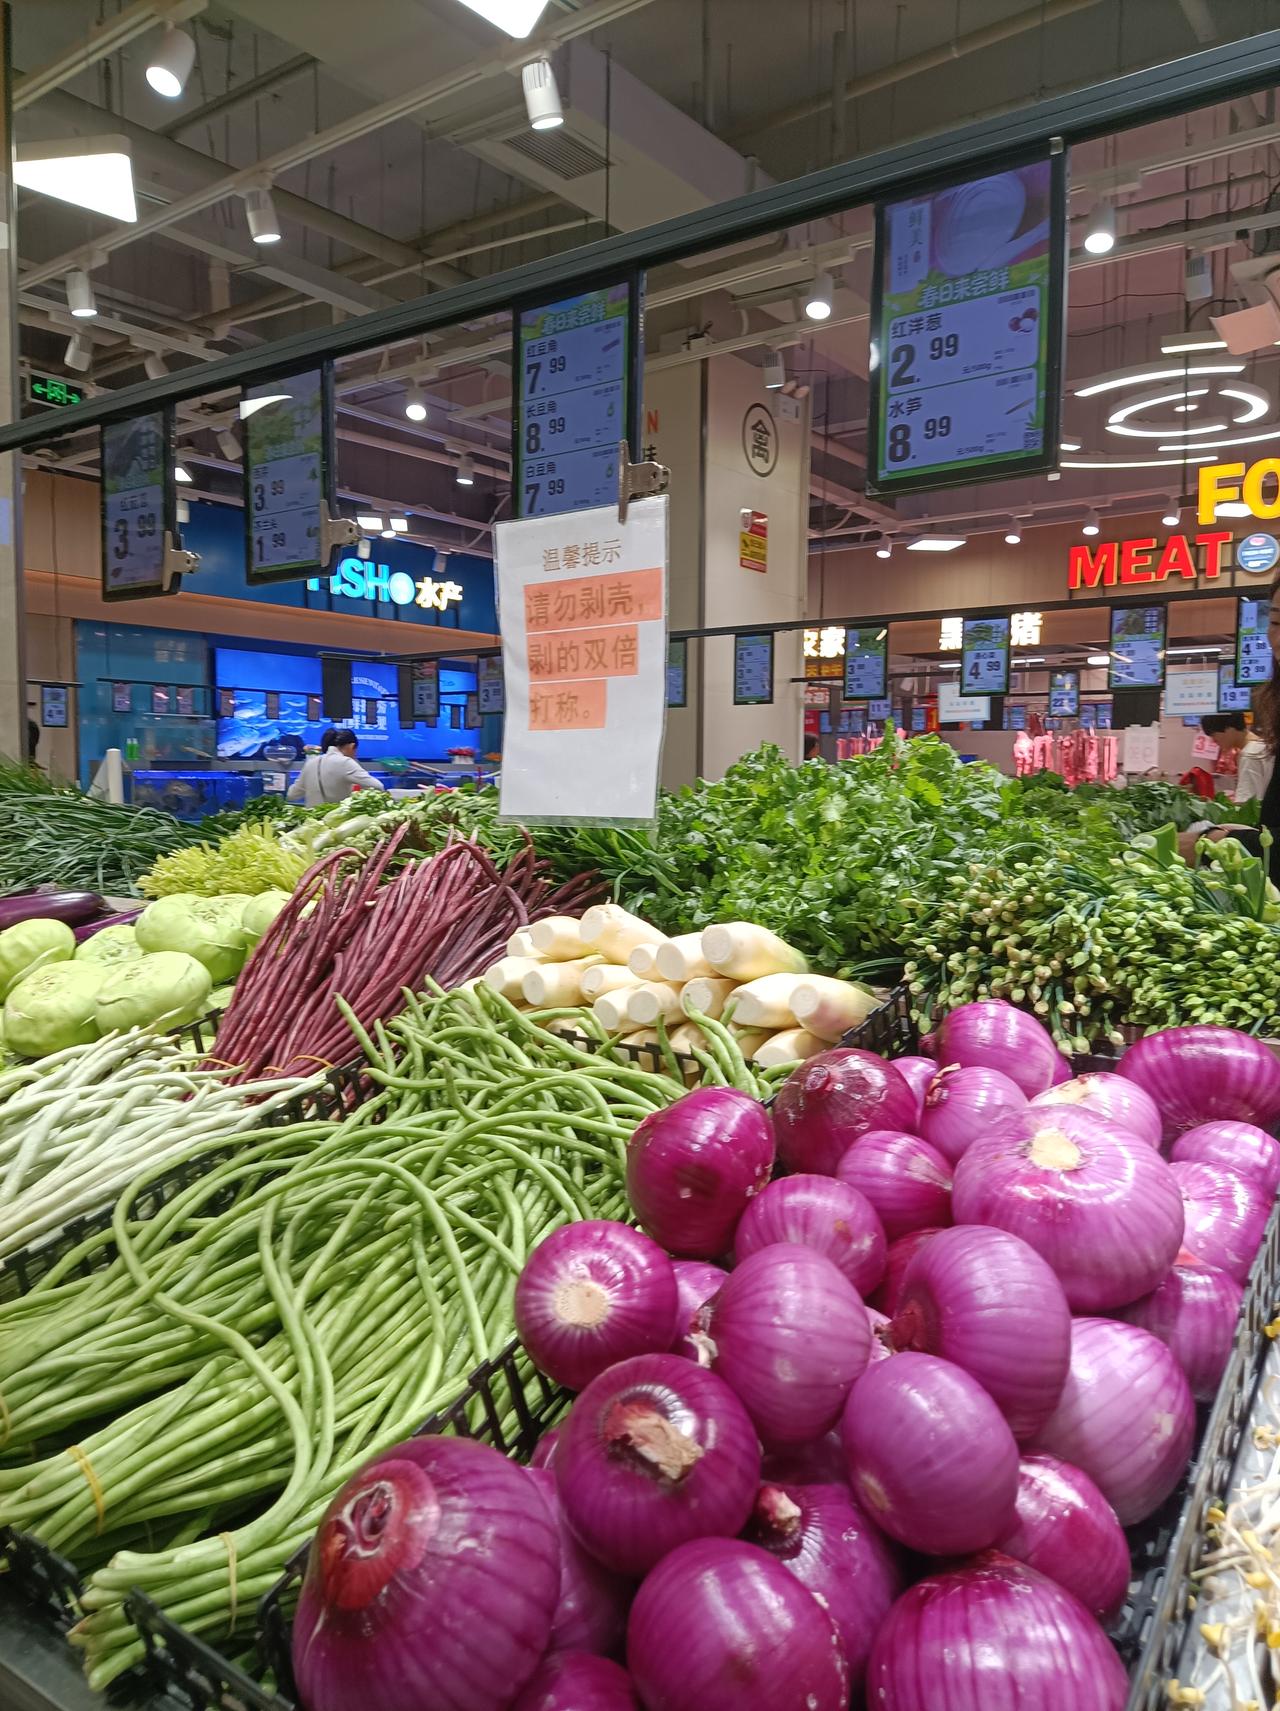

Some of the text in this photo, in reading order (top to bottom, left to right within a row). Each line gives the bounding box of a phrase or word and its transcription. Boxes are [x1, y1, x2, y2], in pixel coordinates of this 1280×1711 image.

[891, 313, 942, 339] 红洋葱
[543, 539, 622, 572] 温馨提示
[1068, 531, 1233, 590] MEAT
[415, 577, 463, 611] 水产
[528, 633, 637, 676] 剥的双倍
